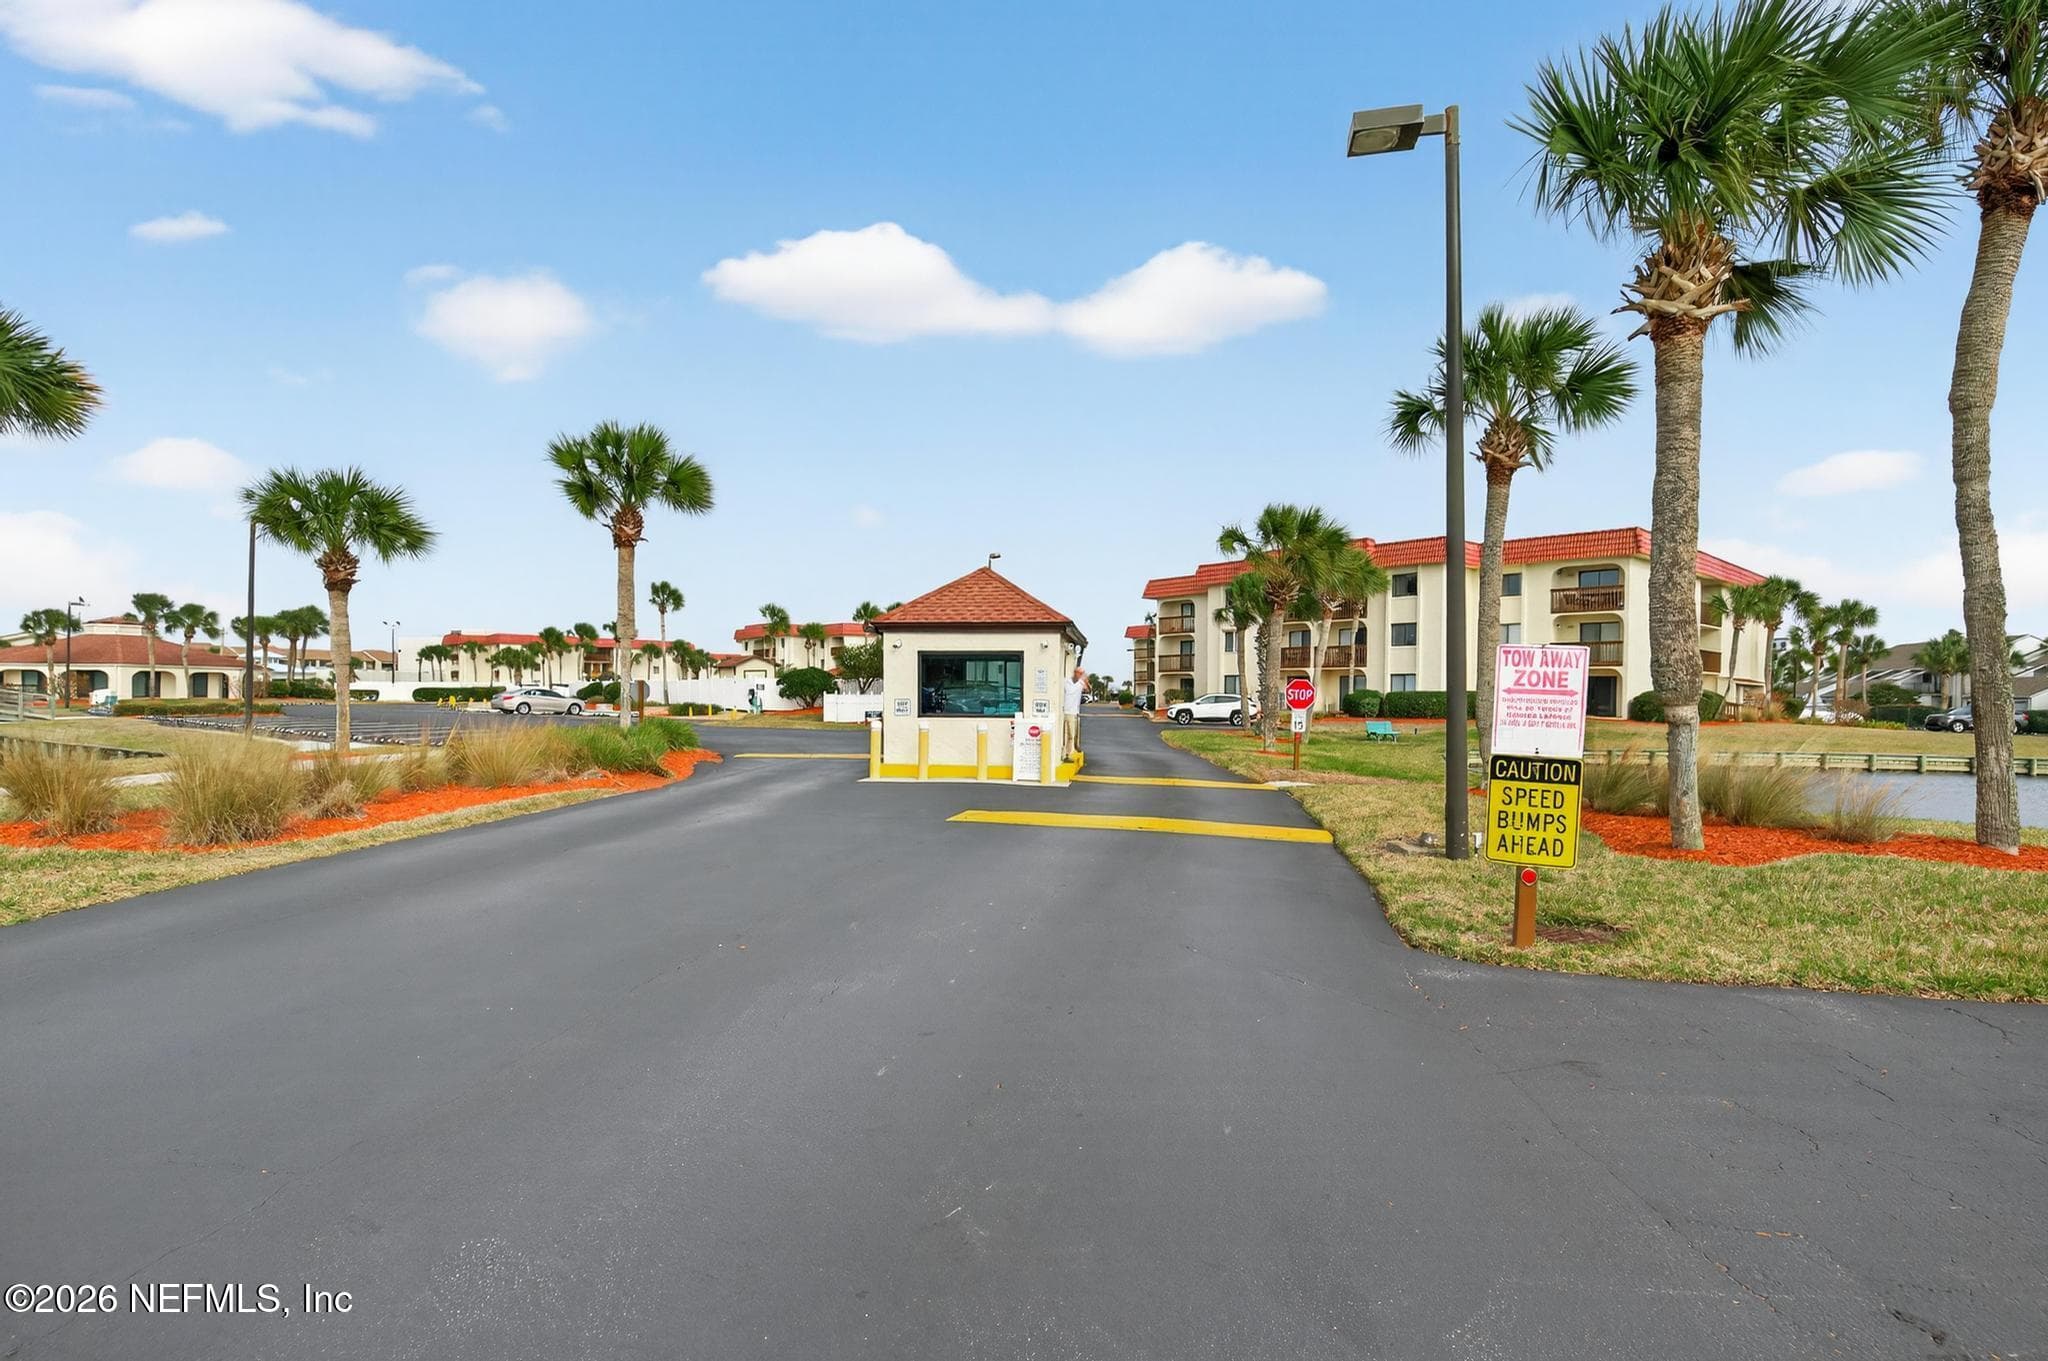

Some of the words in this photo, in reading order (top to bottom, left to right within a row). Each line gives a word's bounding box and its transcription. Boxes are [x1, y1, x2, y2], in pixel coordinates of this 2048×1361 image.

[1502, 649, 1535, 668] TOW
[1540, 650, 1582, 669] AWAY
[1513, 669, 1569, 688] ZONE
[1287, 688, 1313, 701] STOP
[1495, 759, 1576, 782] CAUTION
[1502, 786, 1564, 809] SPEED
[1497, 810, 1566, 834] BUMPS
[1496, 833, 1564, 857] AHEAD
